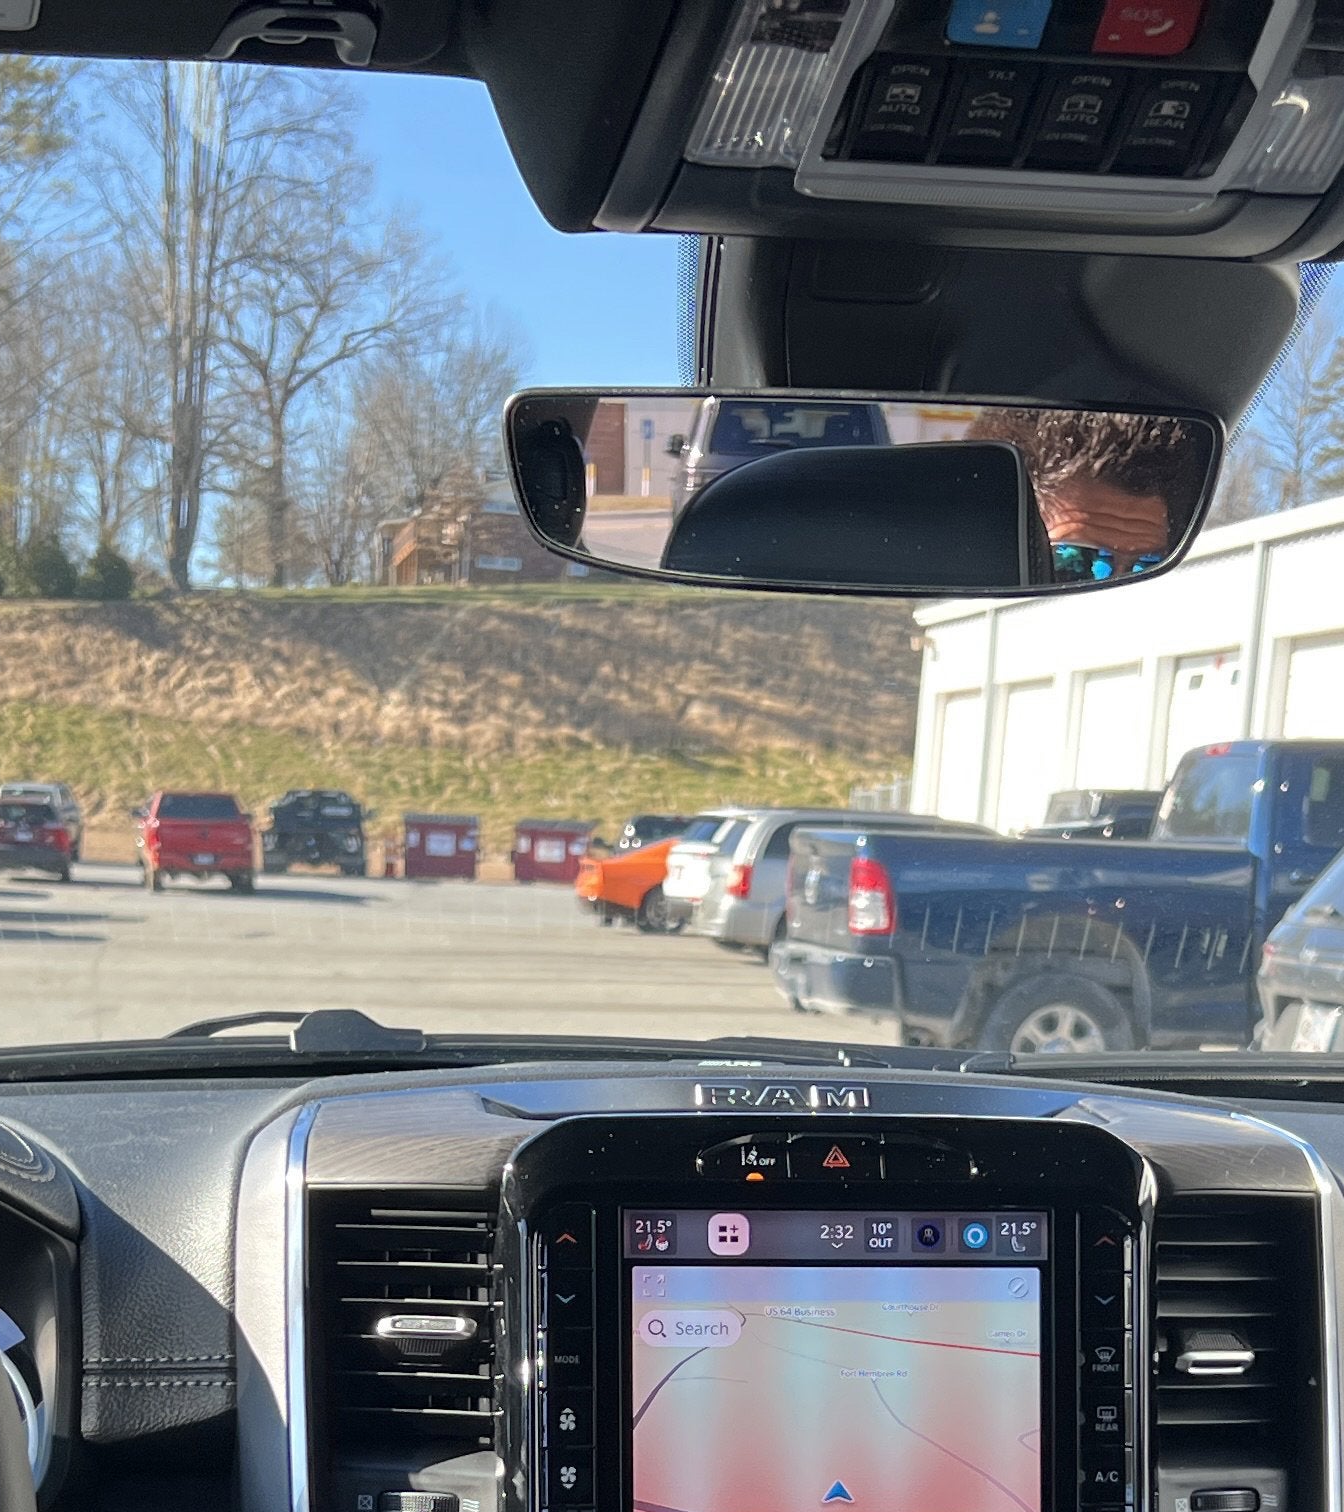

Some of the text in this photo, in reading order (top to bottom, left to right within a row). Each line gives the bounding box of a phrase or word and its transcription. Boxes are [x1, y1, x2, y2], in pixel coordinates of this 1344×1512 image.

[878, 104, 921, 115] AUTO
[968, 108, 1007, 120] VENT
[1056, 112, 1098, 125] AUTO
[694, 1083, 870, 1108] RAM
[759, 1157, 776, 1166] OFF
[635, 1219, 672, 1234] 21.5°
[820, 1224, 854, 1240] 2:32
[871, 1222, 892, 1235] 10°
[1000, 1222, 1037, 1236] 21.5°
[869, 1237, 893, 1249] OUT
[795, 1307, 836, 1317] Business
[675, 1322, 729, 1336] Search
[554, 1355, 580, 1364] MODE
[1092, 1364, 1120, 1373] FRONT
[1095, 1423, 1119, 1432] REAR
[1095, 1471, 1119, 1482] A/C
